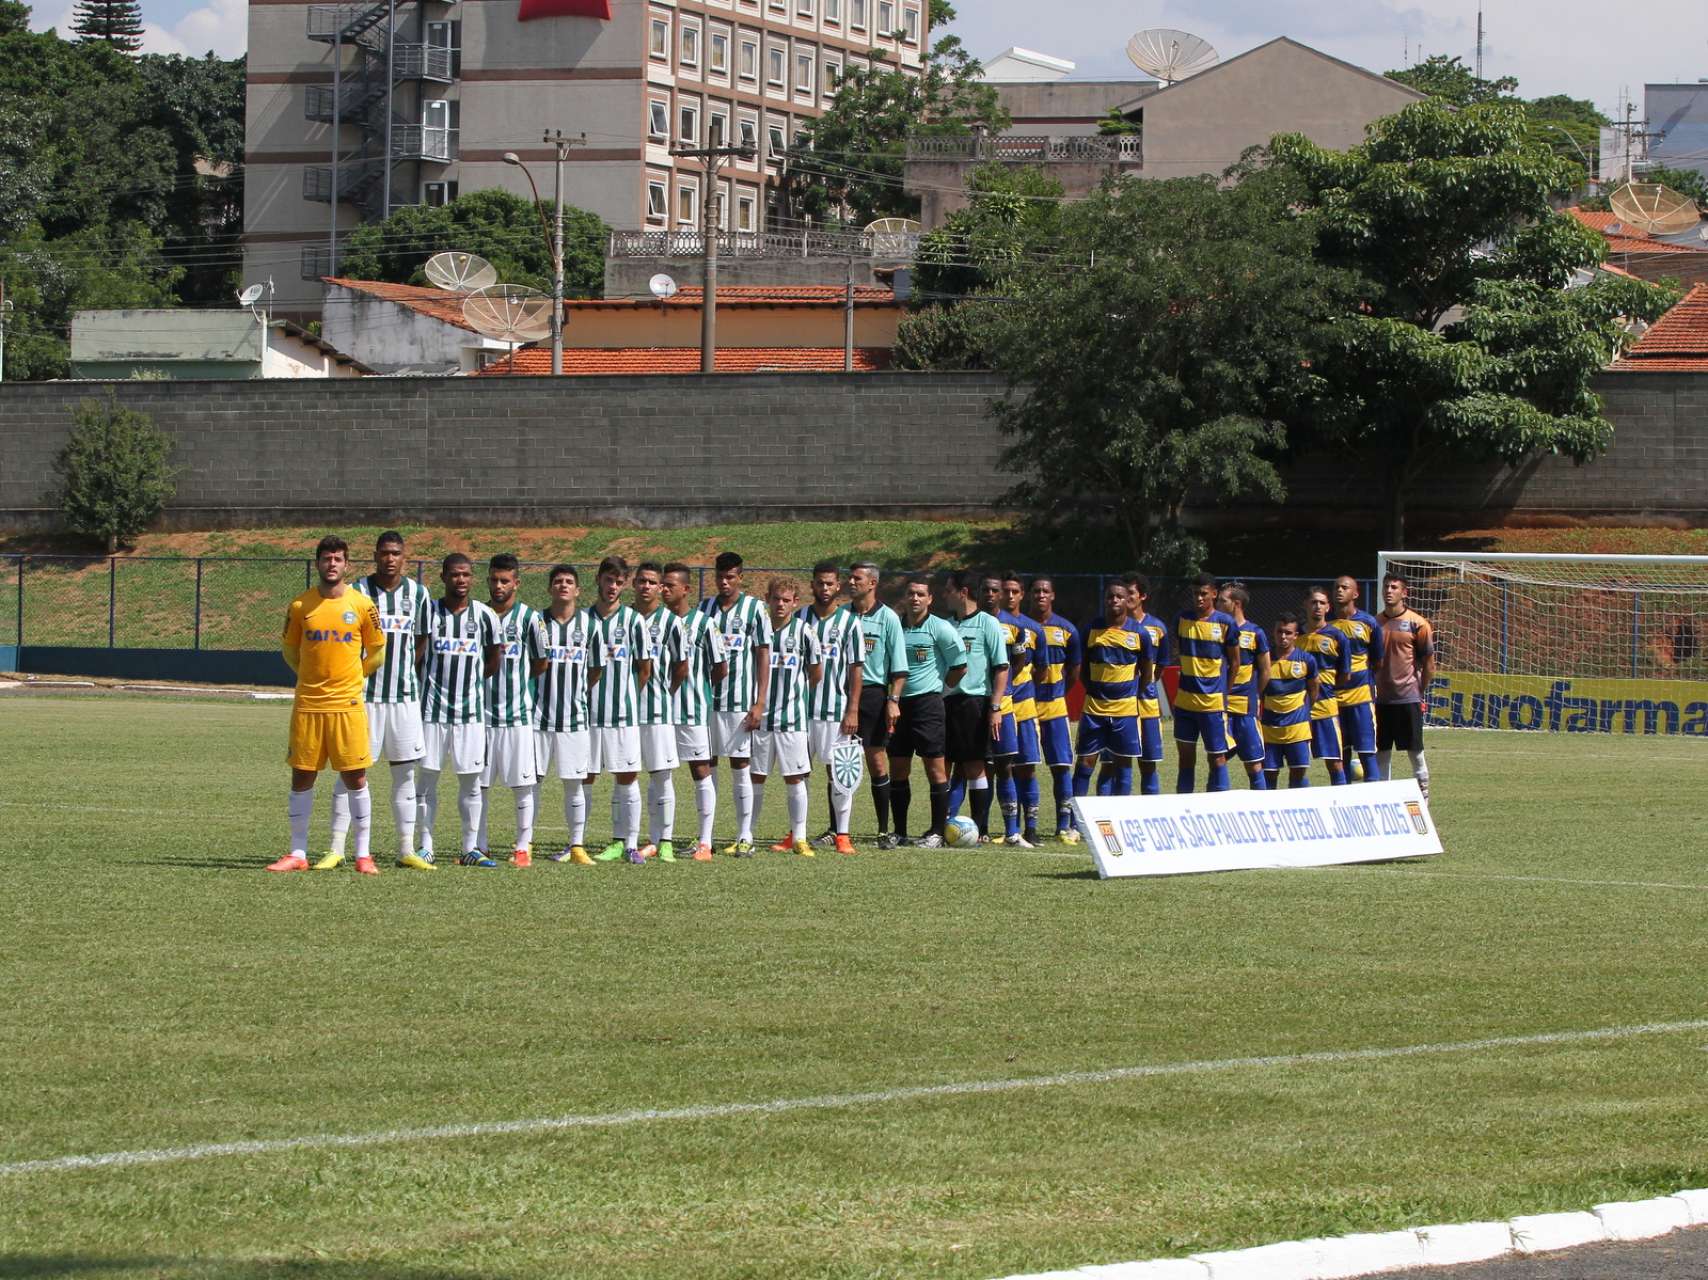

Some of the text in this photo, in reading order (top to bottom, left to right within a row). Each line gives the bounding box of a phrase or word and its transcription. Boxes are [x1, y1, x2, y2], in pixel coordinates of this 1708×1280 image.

[380, 617, 412, 630] AIXA
[304, 629, 352, 642] CAIXA
[434, 639, 478, 653] CAIXA
[549, 648, 583, 661] AIXA
[1425, 678, 1708, 736] Eurofarma
[1143, 816, 1188, 851] COPA
[1179, 808, 1216, 848] SÃO
[1207, 811, 1258, 846] PAULO
[1249, 810, 1277, 843] DE
[1269, 807, 1333, 842] FUTEBOL
[1329, 800, 1380, 839] JÚNIOR
[1374, 803, 1411, 836] 2015
